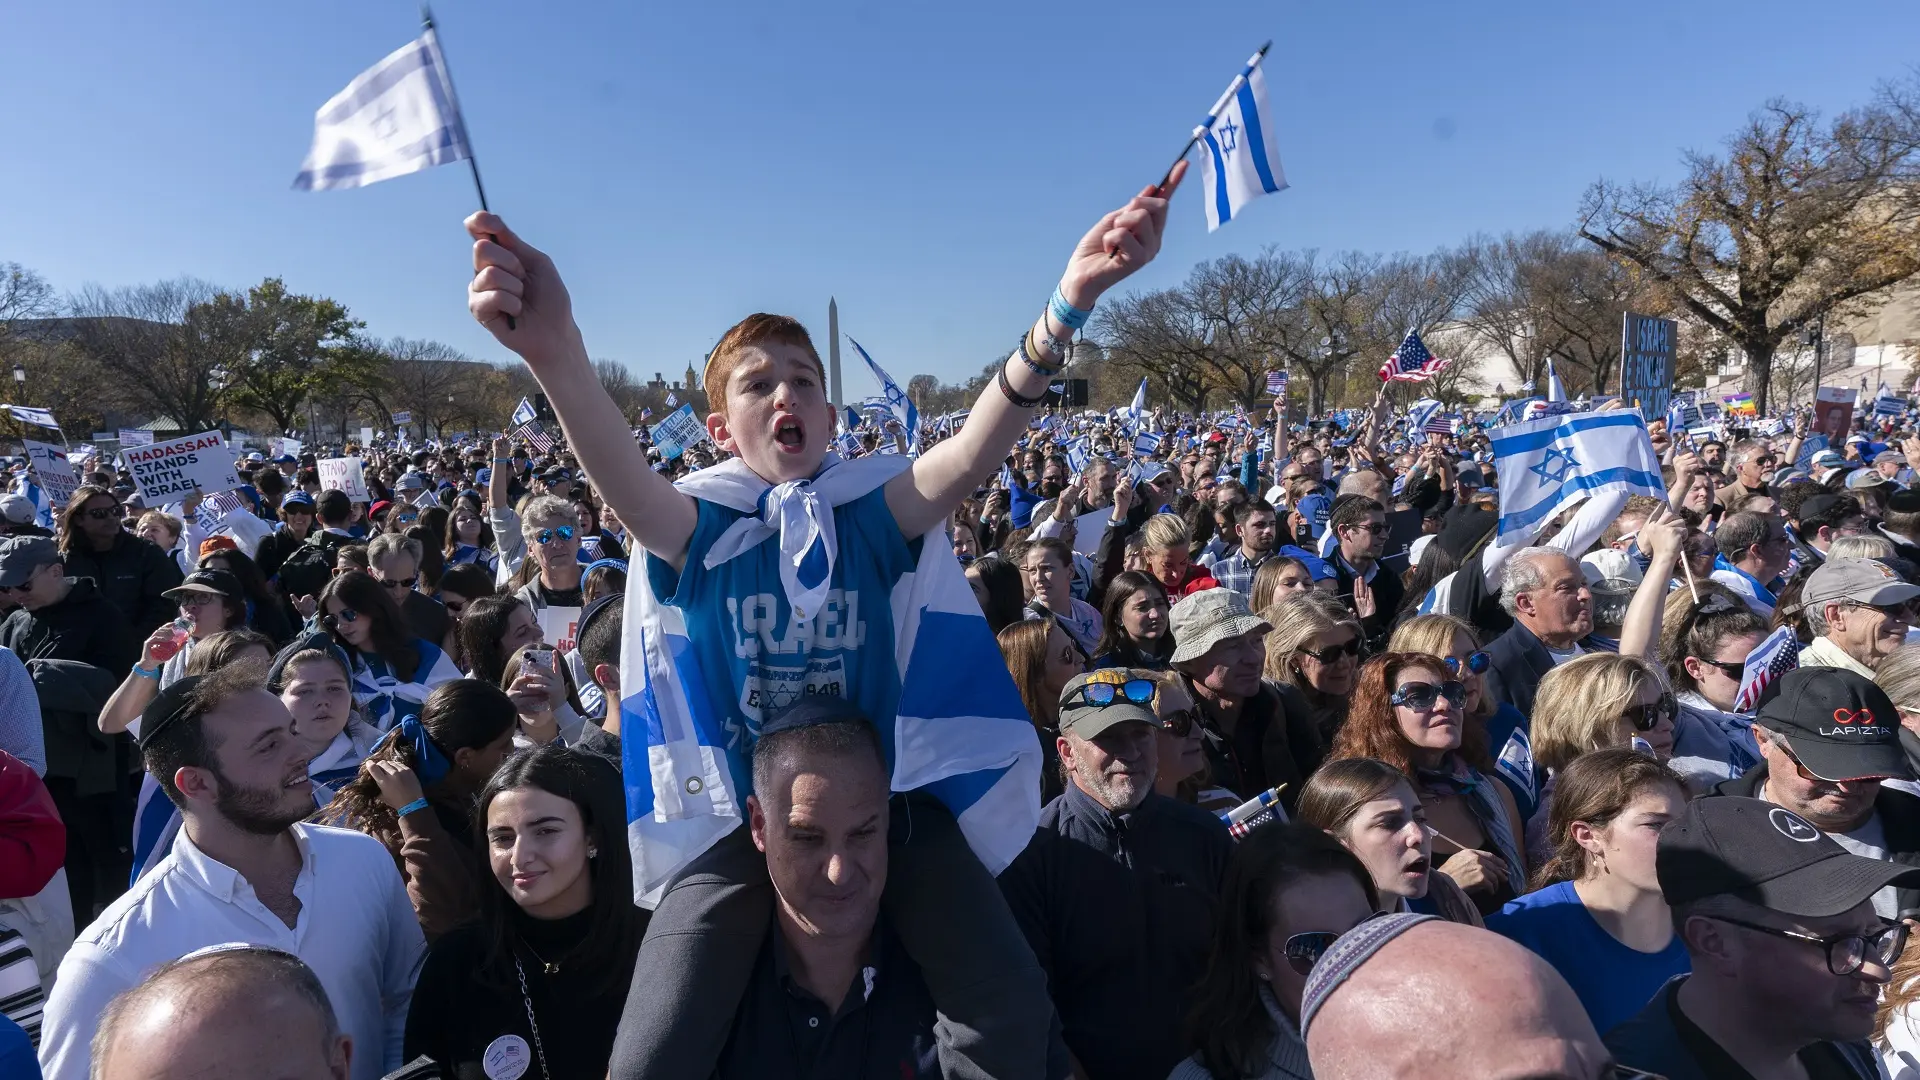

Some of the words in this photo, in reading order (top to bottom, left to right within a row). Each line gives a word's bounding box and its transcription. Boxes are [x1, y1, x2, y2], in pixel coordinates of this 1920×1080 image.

[1636, 318, 1670, 353] ISRAEL
[655, 410, 686, 439] CLEVELAND
[670, 416, 694, 440] STRONGER
[674, 433, 688, 449] THAN
[686, 422, 700, 437] HATE
[128, 435, 220, 464] HADASSAH
[133, 453, 199, 475] STANDS
[320, 461, 348, 477] STAND
[39, 470, 76, 485] HOUSTON
[138, 468, 184, 487] WITH
[143, 478, 202, 498] ISRAEL
[194, 506, 214, 532] AEL
[726, 588, 867, 659] ISRAEL
[1819, 726, 1892, 736] LAPIZTA
